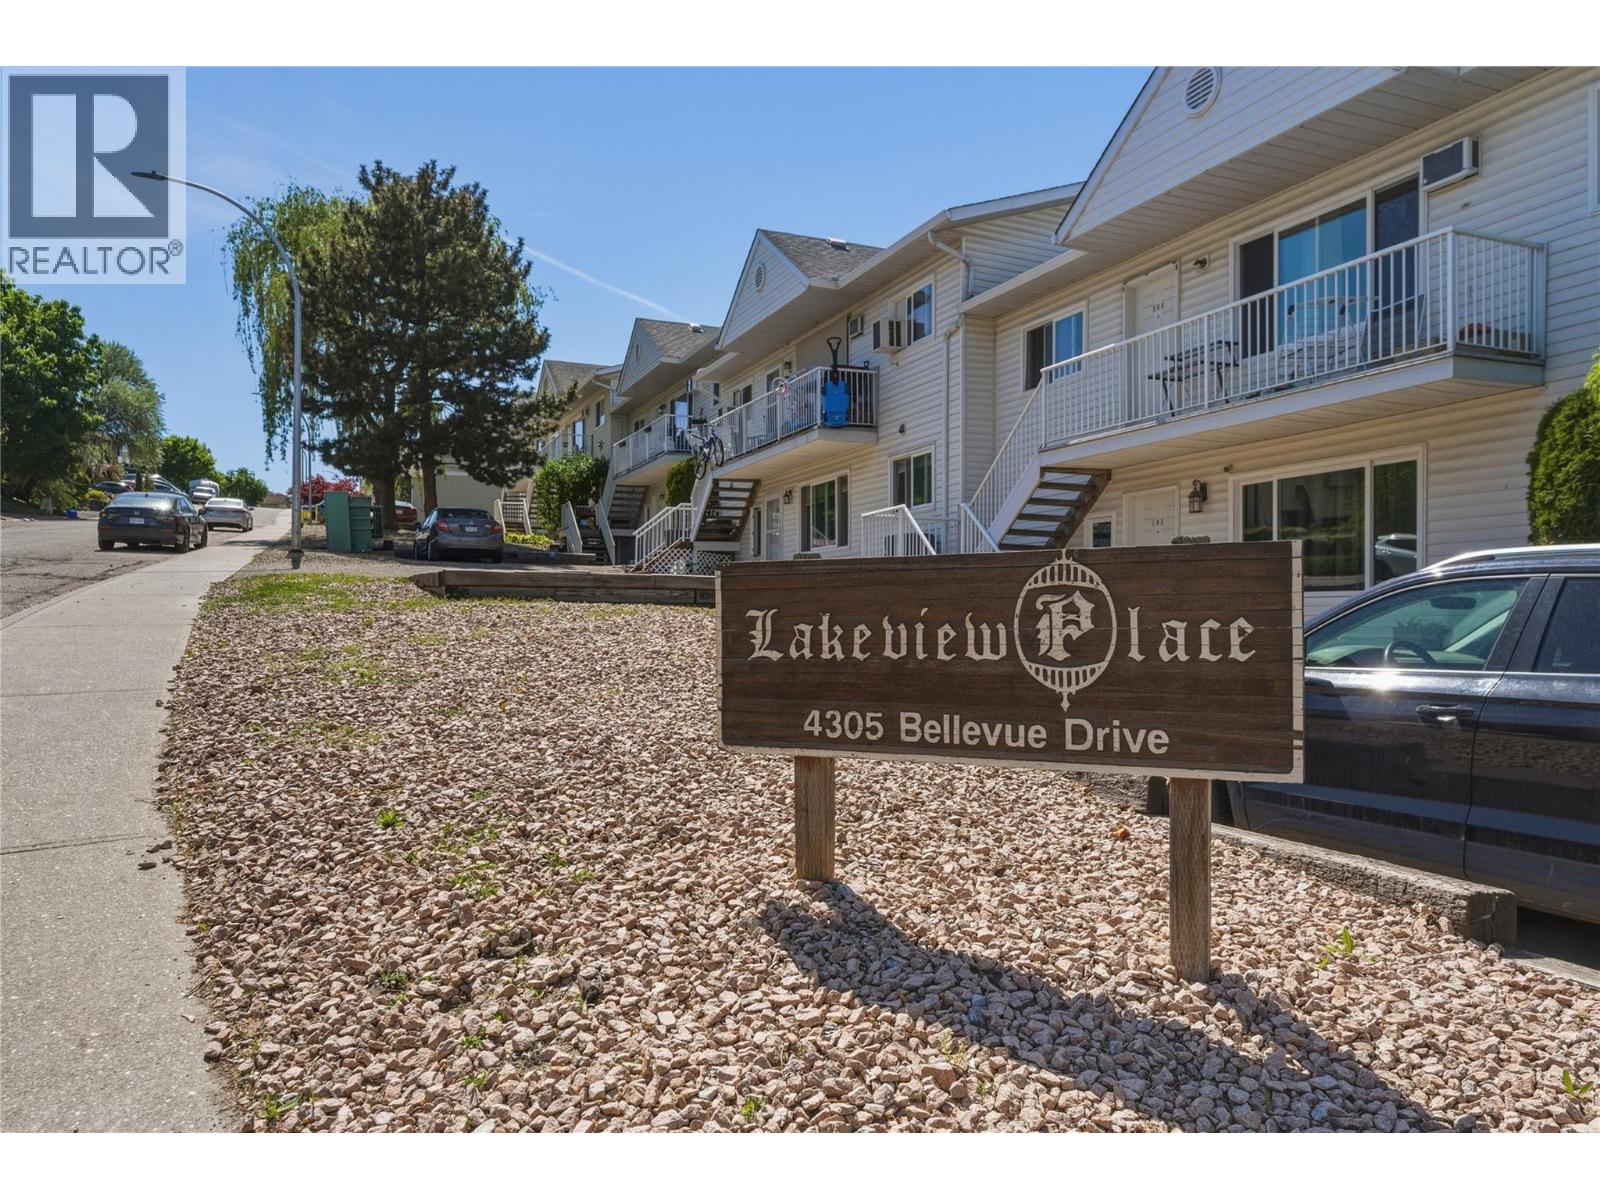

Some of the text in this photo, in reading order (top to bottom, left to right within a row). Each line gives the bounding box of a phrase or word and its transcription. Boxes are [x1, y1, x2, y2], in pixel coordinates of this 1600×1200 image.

[745, 607, 1008, 662] Lakeview
[803, 710, 1170, 755] 4305 Bellevue Drive
